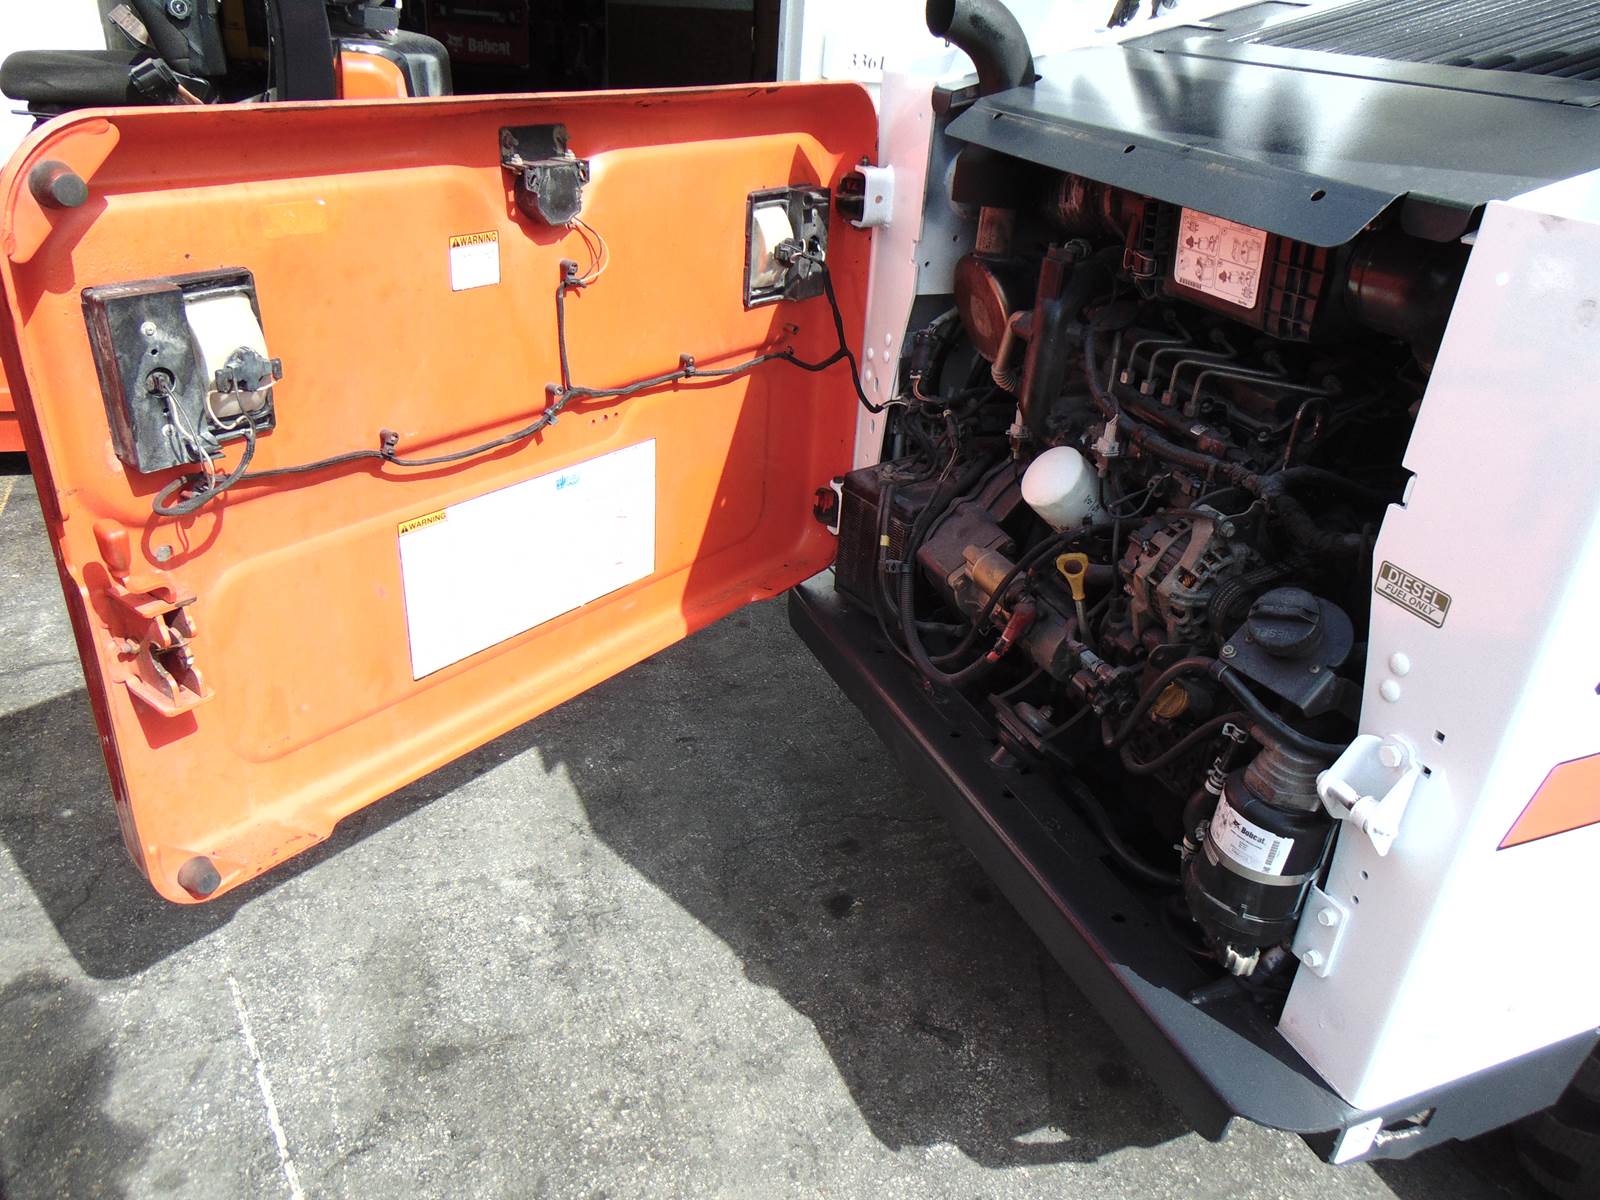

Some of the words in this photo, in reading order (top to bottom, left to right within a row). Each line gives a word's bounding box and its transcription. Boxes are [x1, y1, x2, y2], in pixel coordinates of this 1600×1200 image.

[467, 37, 511, 56] Bobcat
[460, 232, 497, 248] WARNING
[409, 512, 446, 530] WARNING
[1387, 568, 1441, 609] DIESEL
[1385, 583, 1407, 602] FUEL
[1408, 597, 1436, 615] ONLY
[1240, 826, 1266, 844] Bobcat
